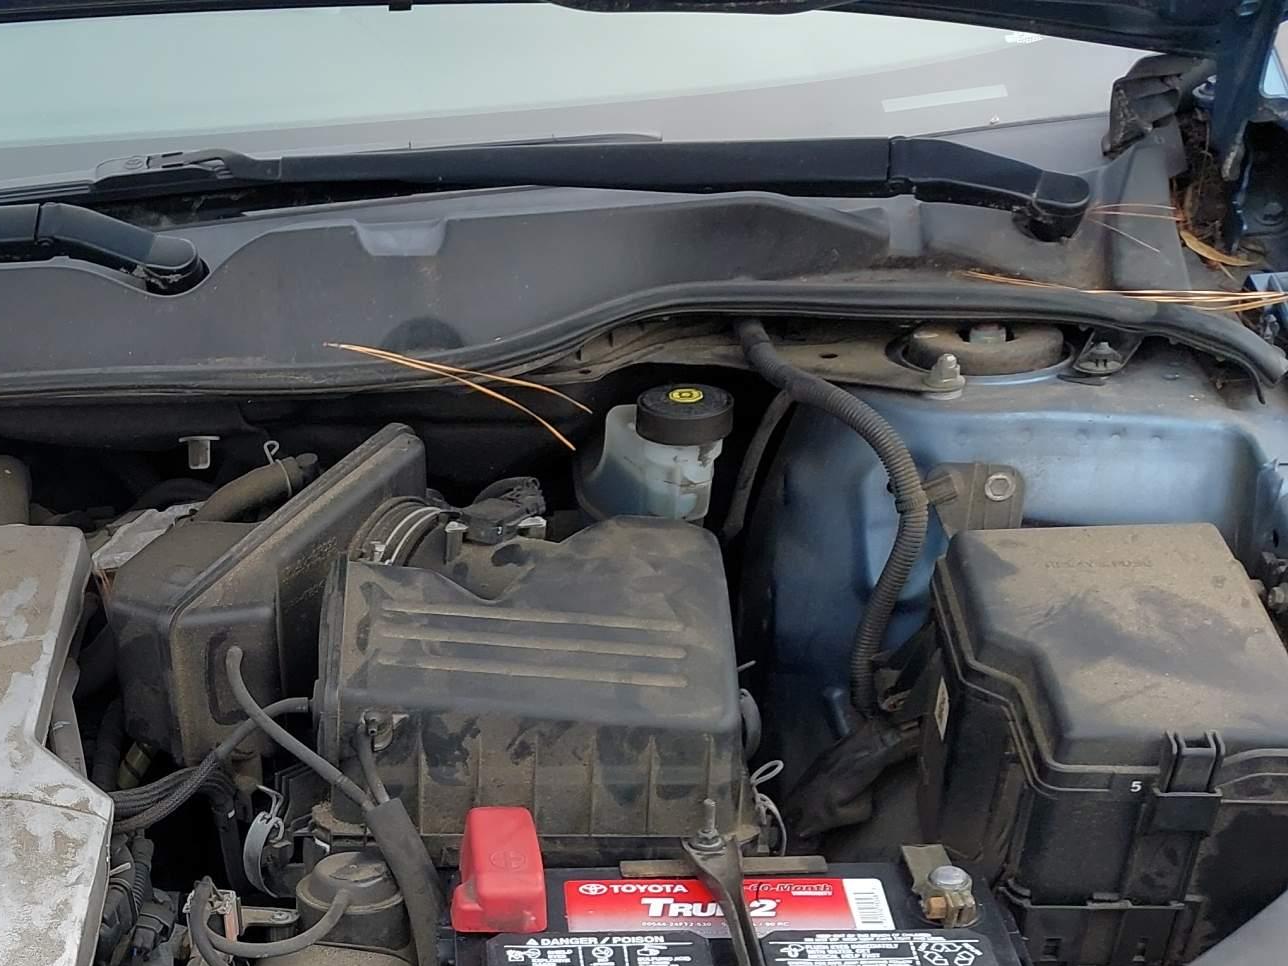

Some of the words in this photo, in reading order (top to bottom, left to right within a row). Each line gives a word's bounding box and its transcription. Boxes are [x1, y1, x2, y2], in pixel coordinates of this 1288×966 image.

[1129, 780, 1144, 793] 5
[610, 884, 689, 893] TOYOTA
[540, 936, 598, 946] DANGER
[612, 935, 665, 945] POISON
